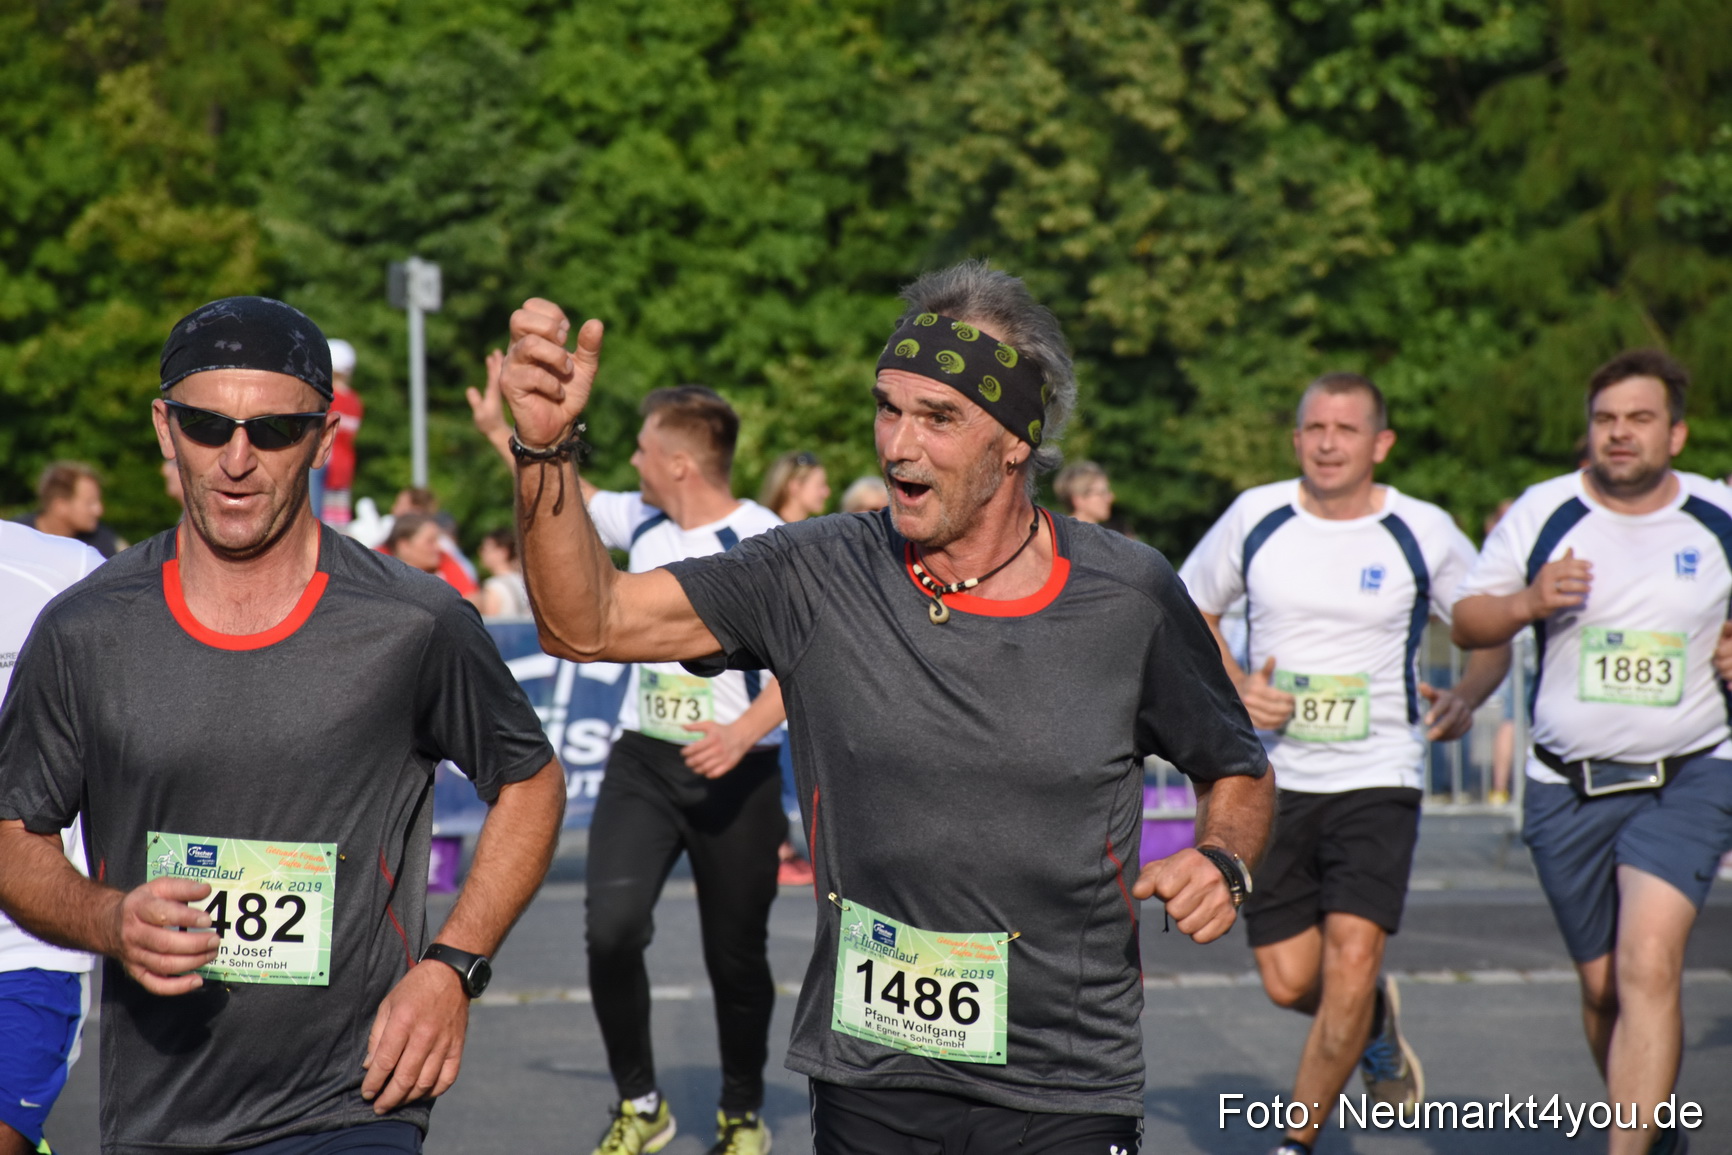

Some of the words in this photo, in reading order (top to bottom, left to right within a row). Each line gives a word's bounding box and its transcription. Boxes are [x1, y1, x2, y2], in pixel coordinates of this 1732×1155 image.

[1594, 655, 1672, 685] 1883
[645, 694, 701, 721] 1873
[173, 862, 245, 881] firmenlauf
[287, 881, 323, 893] 2019
[180, 890, 306, 943] 482
[233, 944, 274, 958] Josef
[861, 934, 919, 965] firmenlauf
[229, 958, 254, 968] Sohn
[256, 961, 288, 970] GmbH
[960, 969, 995, 980] 2019
[856, 959, 981, 1026] 1486
[865, 1007, 899, 1027] Pfann
[902, 1018, 967, 1041] Wolfgang
[865, 1021, 874, 1029] M.
[876, 1025, 901, 1038] Egner
[909, 1034, 933, 1045] Sohn
[935, 1039, 965, 1049] GmbH
